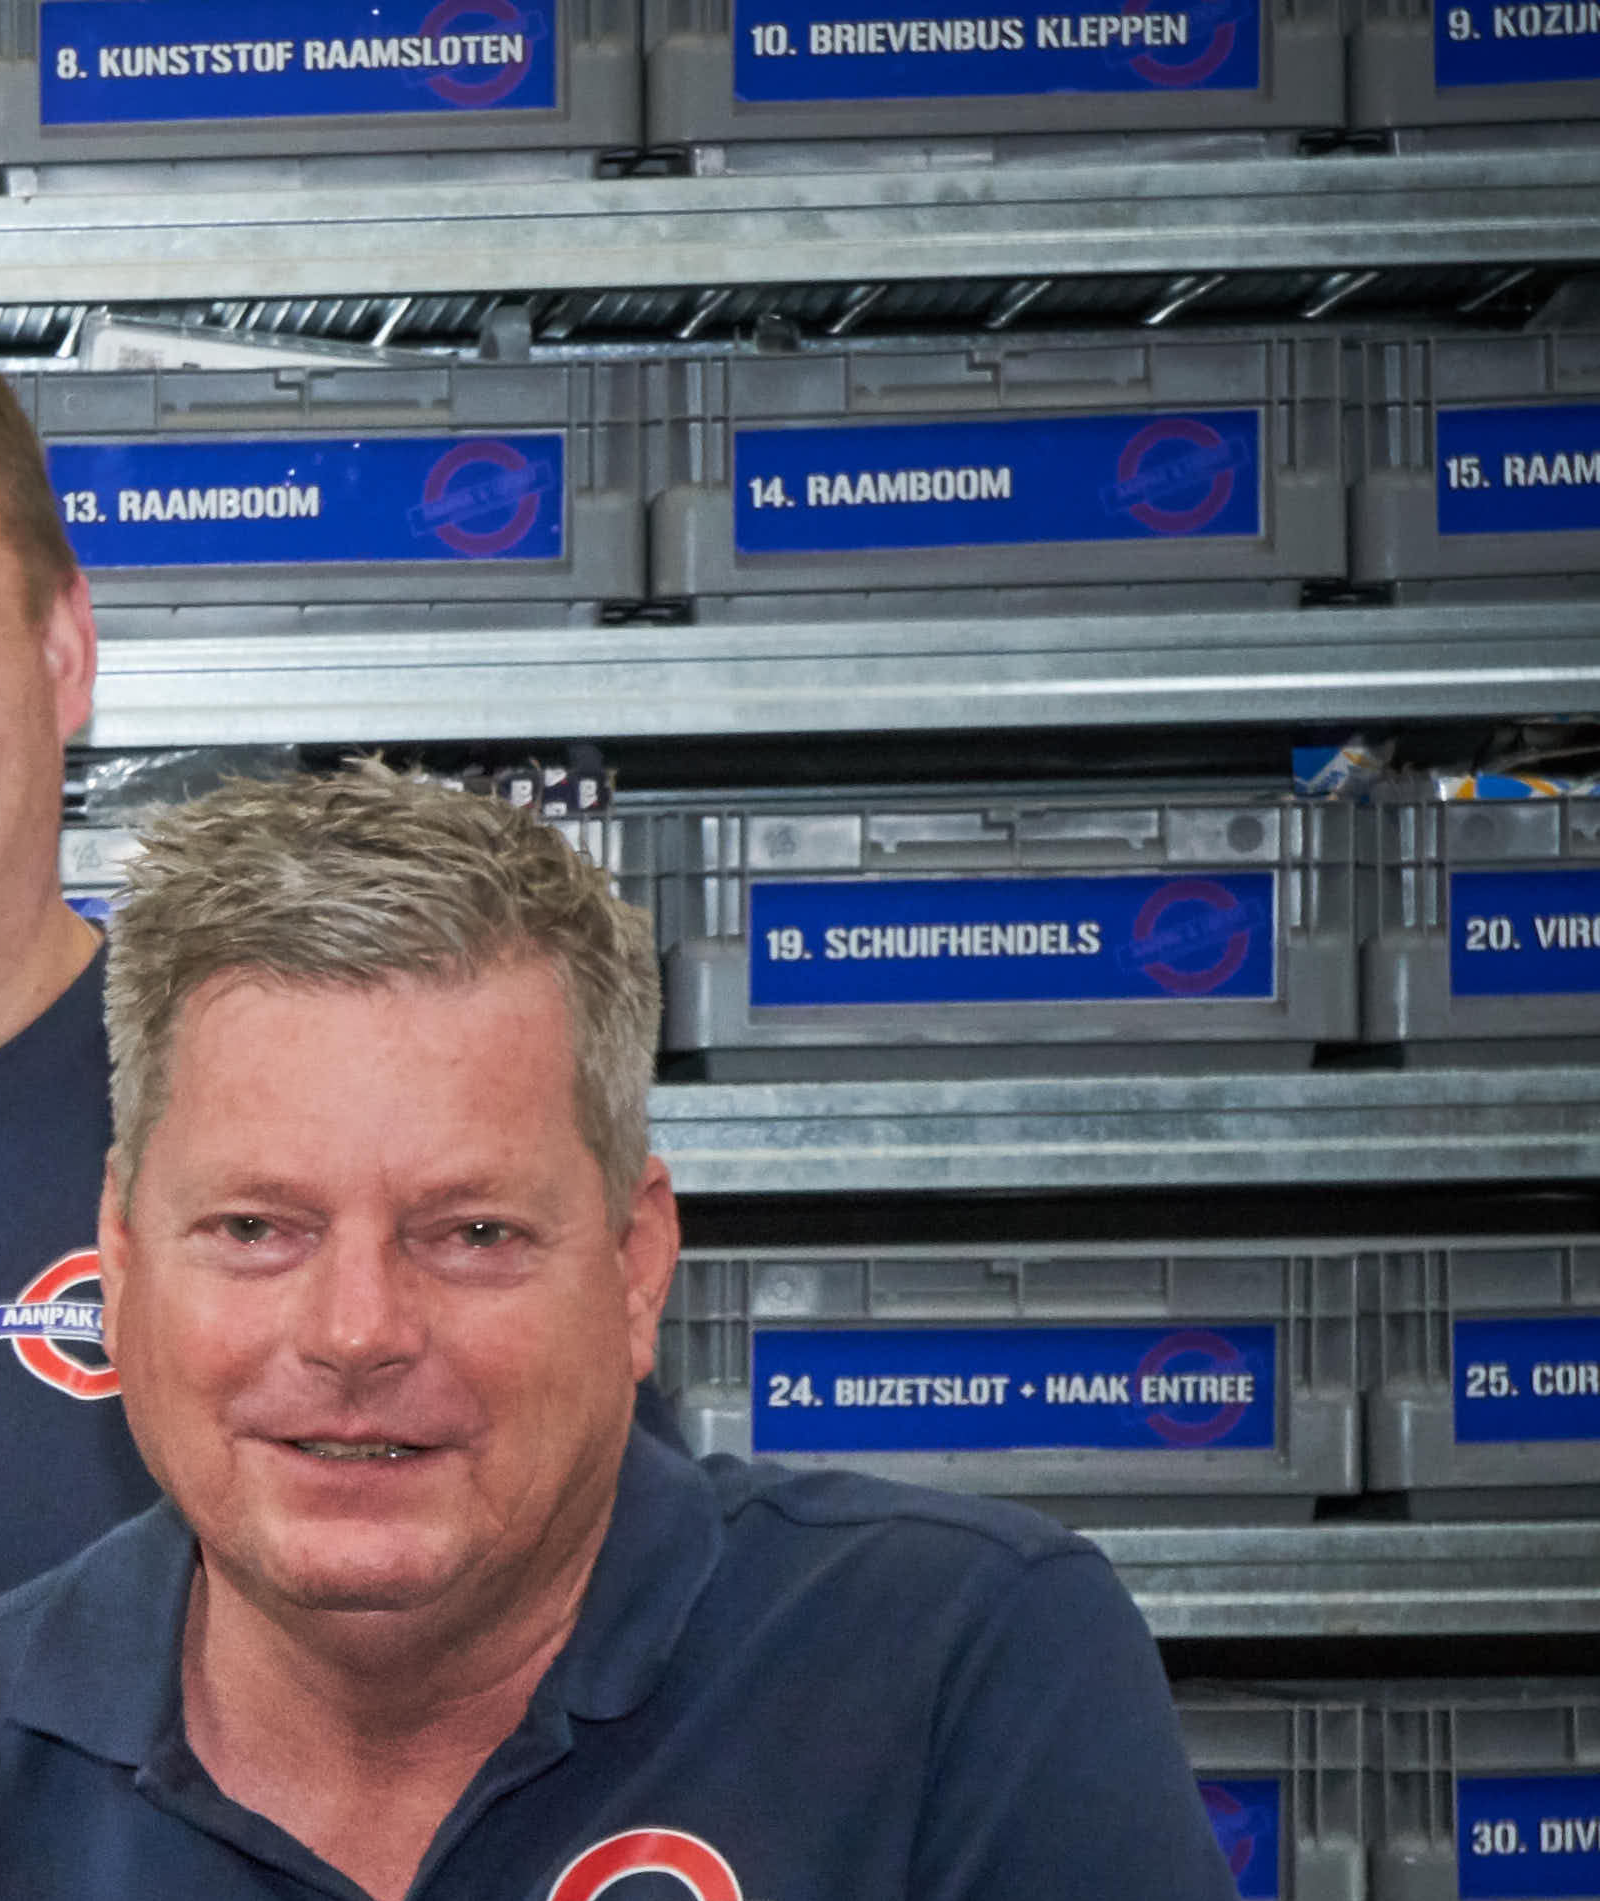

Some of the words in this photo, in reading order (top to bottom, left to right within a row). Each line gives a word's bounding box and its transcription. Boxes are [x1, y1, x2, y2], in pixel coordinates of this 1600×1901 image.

[749, 23, 798, 57] 10.
[808, 17, 1026, 56] BRIEVENBUS
[1036, 12, 1188, 50] KLEPPEN
[1447, 7, 1482, 42] 9.
[55, 46, 89, 81] 8.
[97, 39, 295, 79] KUNSTSTOF
[303, 32, 525, 72] RAAMSLOTEN
[747, 475, 797, 510] 14.
[806, 466, 1012, 508] RAAMBOOM
[1445, 455, 1491, 490] 15.
[1503, 451, 1600, 488] RAAM
[61, 489, 108, 524] 13.
[117, 485, 321, 522] RAAMBOOM
[765, 927, 814, 962] 19.
[823, 921, 1102, 961] SCHUIFHENDELS
[1464, 916, 1522, 952] 20.
[1, 1305, 95, 1327] AANPAK
[767, 1373, 824, 1408] 24.
[833, 1374, 1011, 1408] BIJZETSLOT
[1018, 1379, 1038, 1400] +
[1044, 1374, 1131, 1405] HAAK
[1139, 1373, 1255, 1405] ENTREE
[1464, 1363, 1520, 1399] 25.
[1531, 1363, 1600, 1397] COR
[1471, 1819, 1528, 1856] 30.
